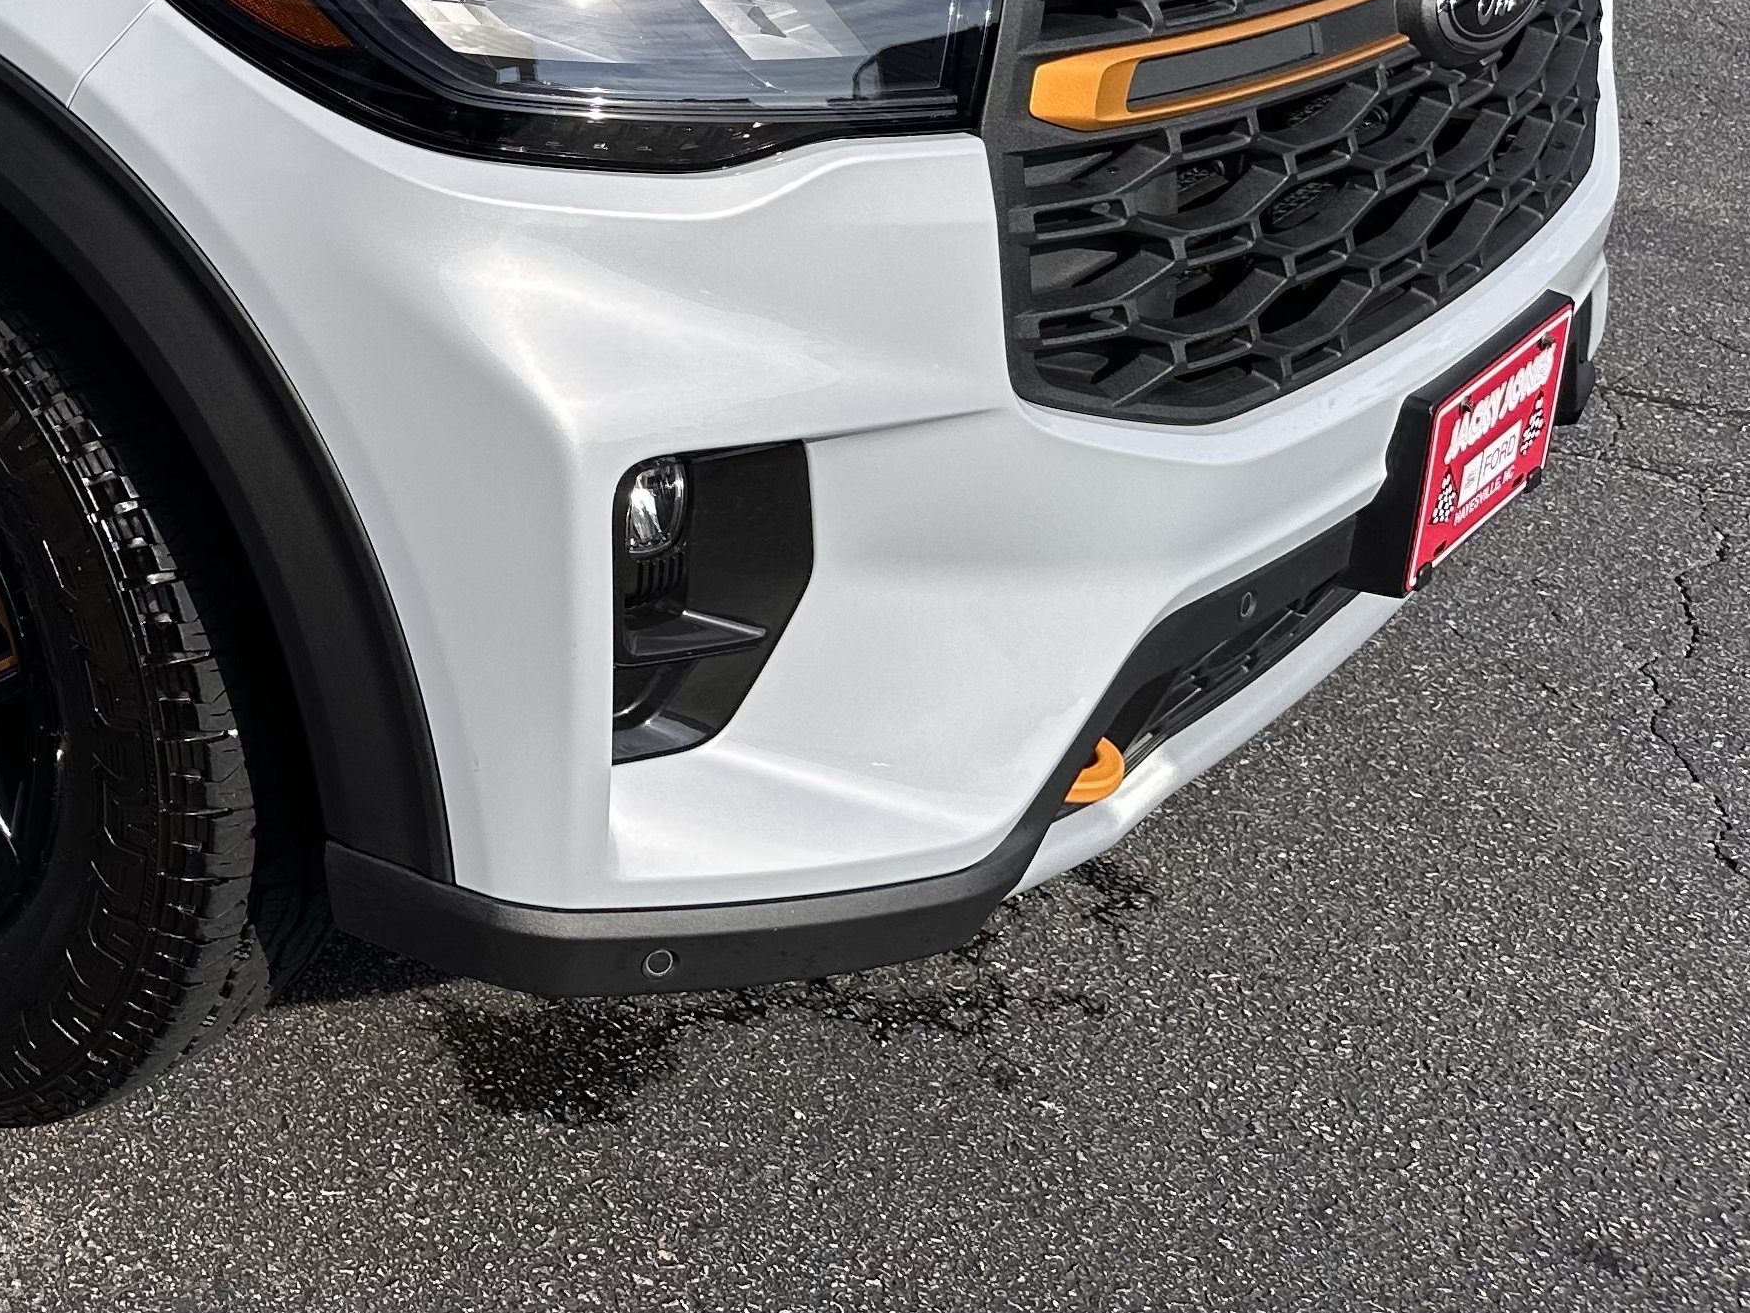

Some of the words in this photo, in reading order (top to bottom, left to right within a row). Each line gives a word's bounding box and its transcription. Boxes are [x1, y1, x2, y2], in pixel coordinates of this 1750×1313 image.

[1444, 381, 1507, 465] JACKY
[1498, 343, 1555, 420] JONES
[1482, 434, 1516, 477] FORD
